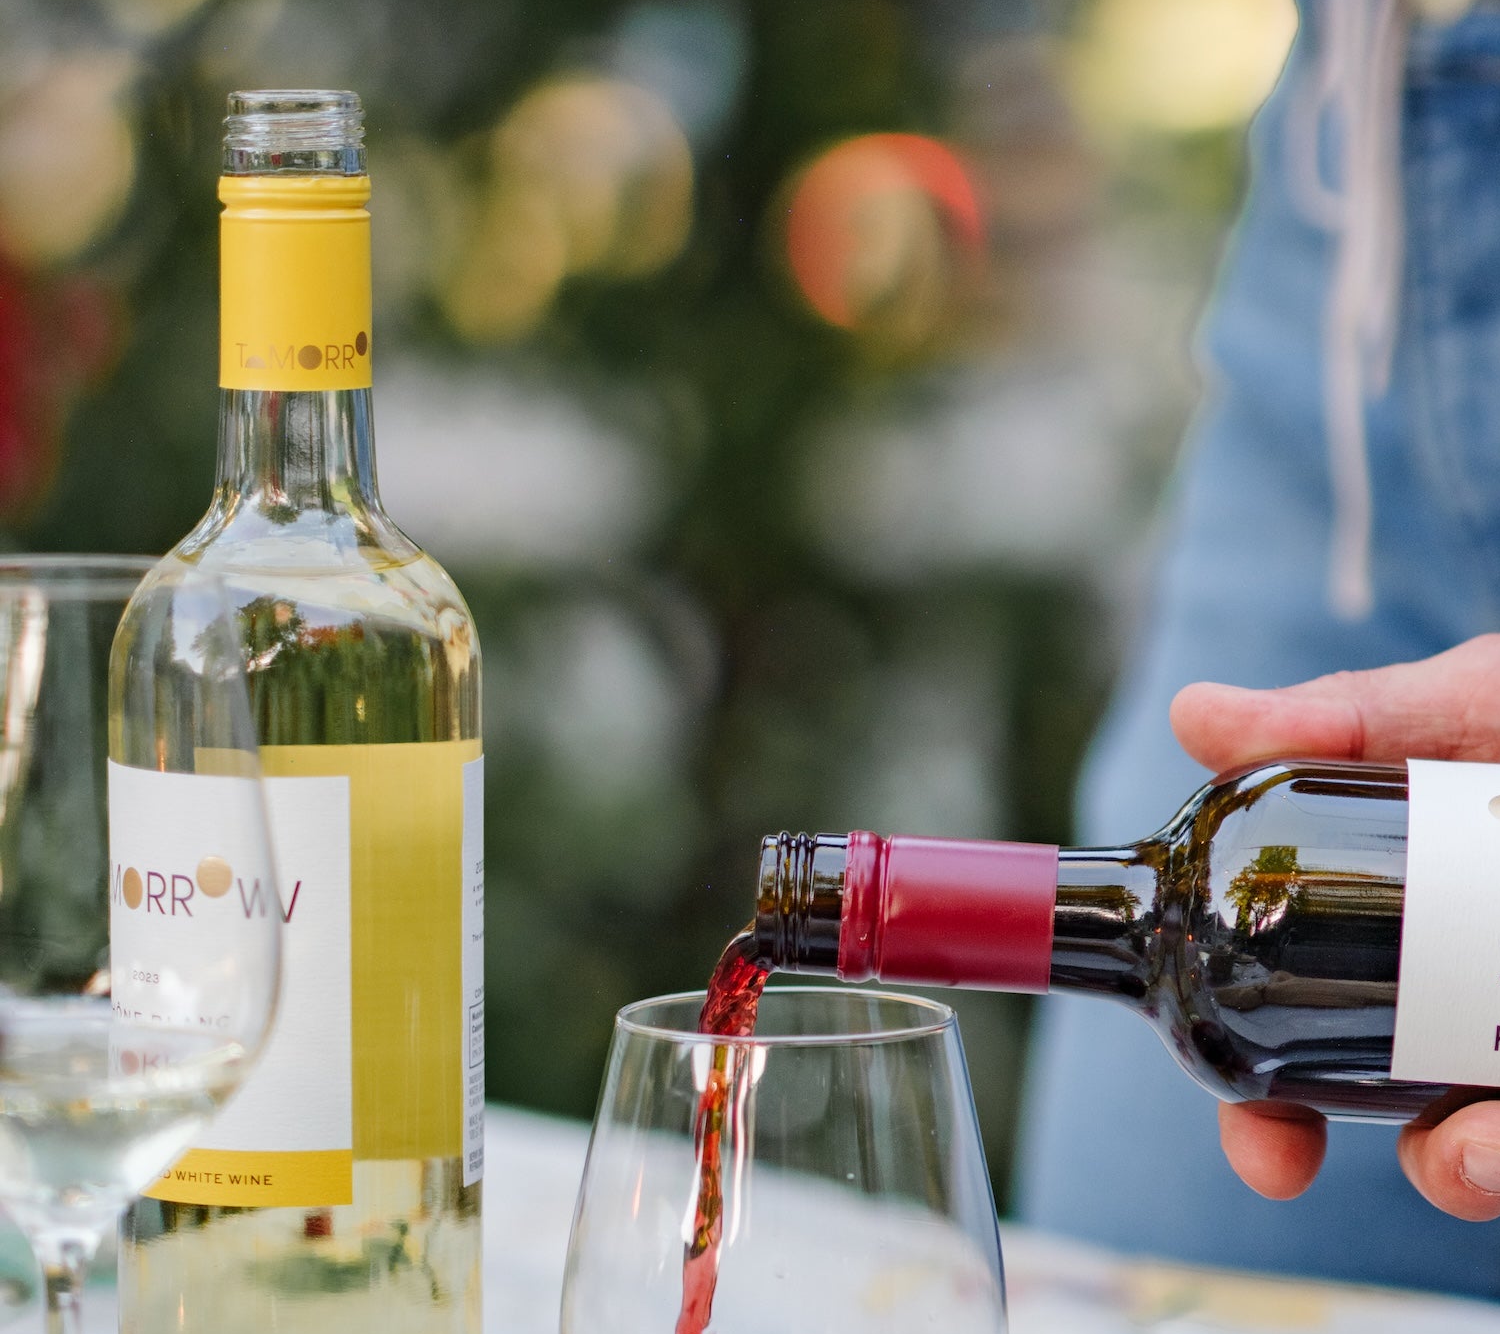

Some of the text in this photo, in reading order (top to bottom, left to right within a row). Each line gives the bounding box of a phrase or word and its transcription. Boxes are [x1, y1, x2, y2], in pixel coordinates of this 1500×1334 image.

[132, 969, 160, 984] 2023
[175, 1170, 223, 1185] WHITE
[228, 1174, 273, 1186] WINE
